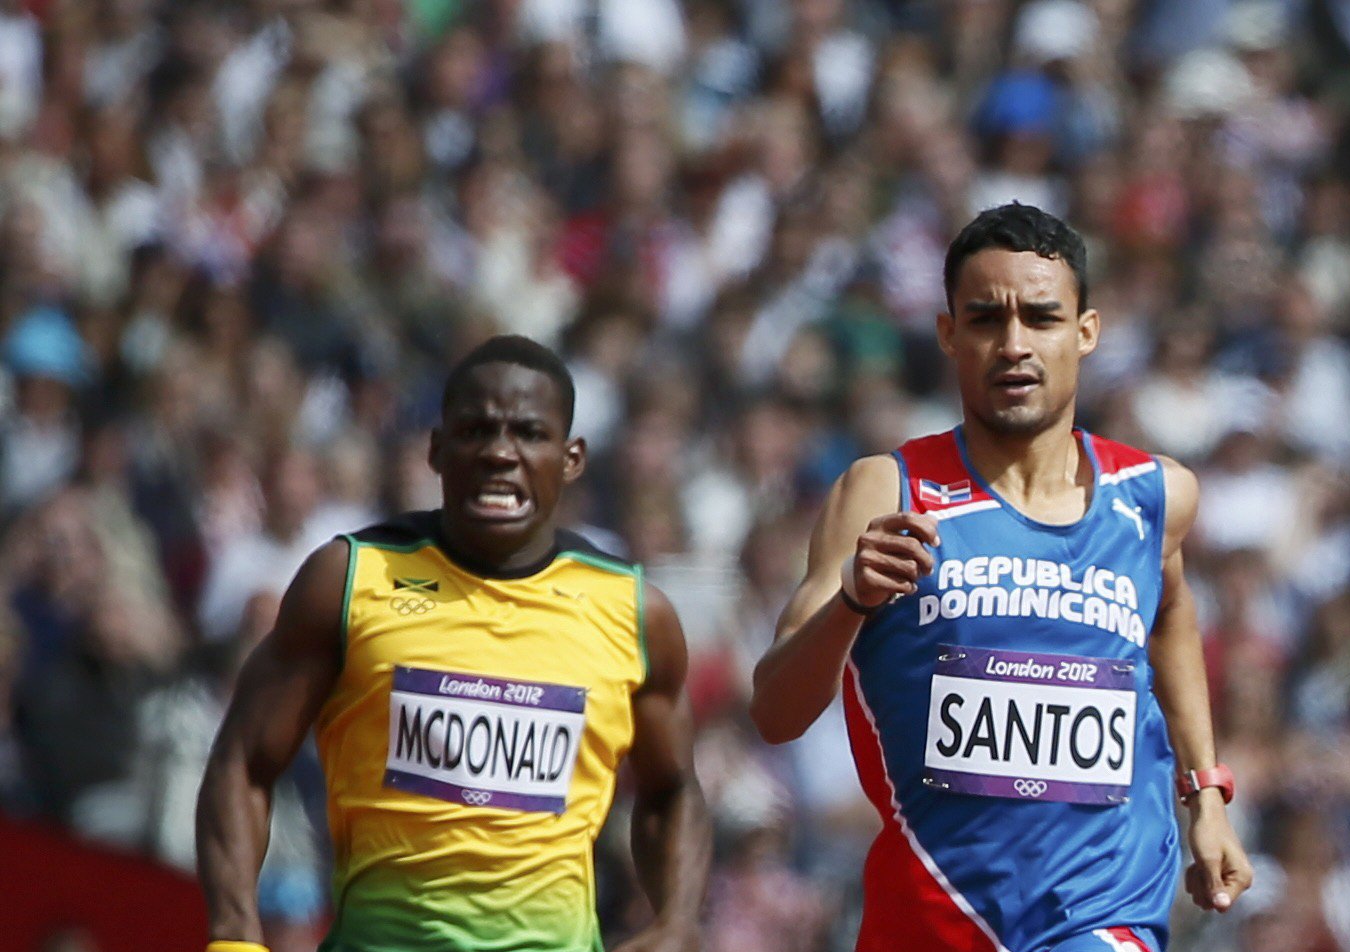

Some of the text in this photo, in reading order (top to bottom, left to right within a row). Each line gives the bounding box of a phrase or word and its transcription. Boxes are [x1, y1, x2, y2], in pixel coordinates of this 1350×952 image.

[938, 556, 1138, 610] REPUBLICA
[918, 586, 1147, 648] DOMINICANA
[439, 674, 545, 706] London 2012
[985, 655, 1098, 682] London 2012
[395, 704, 570, 782] MCDONALD
[936, 692, 1126, 771] SANTOS
